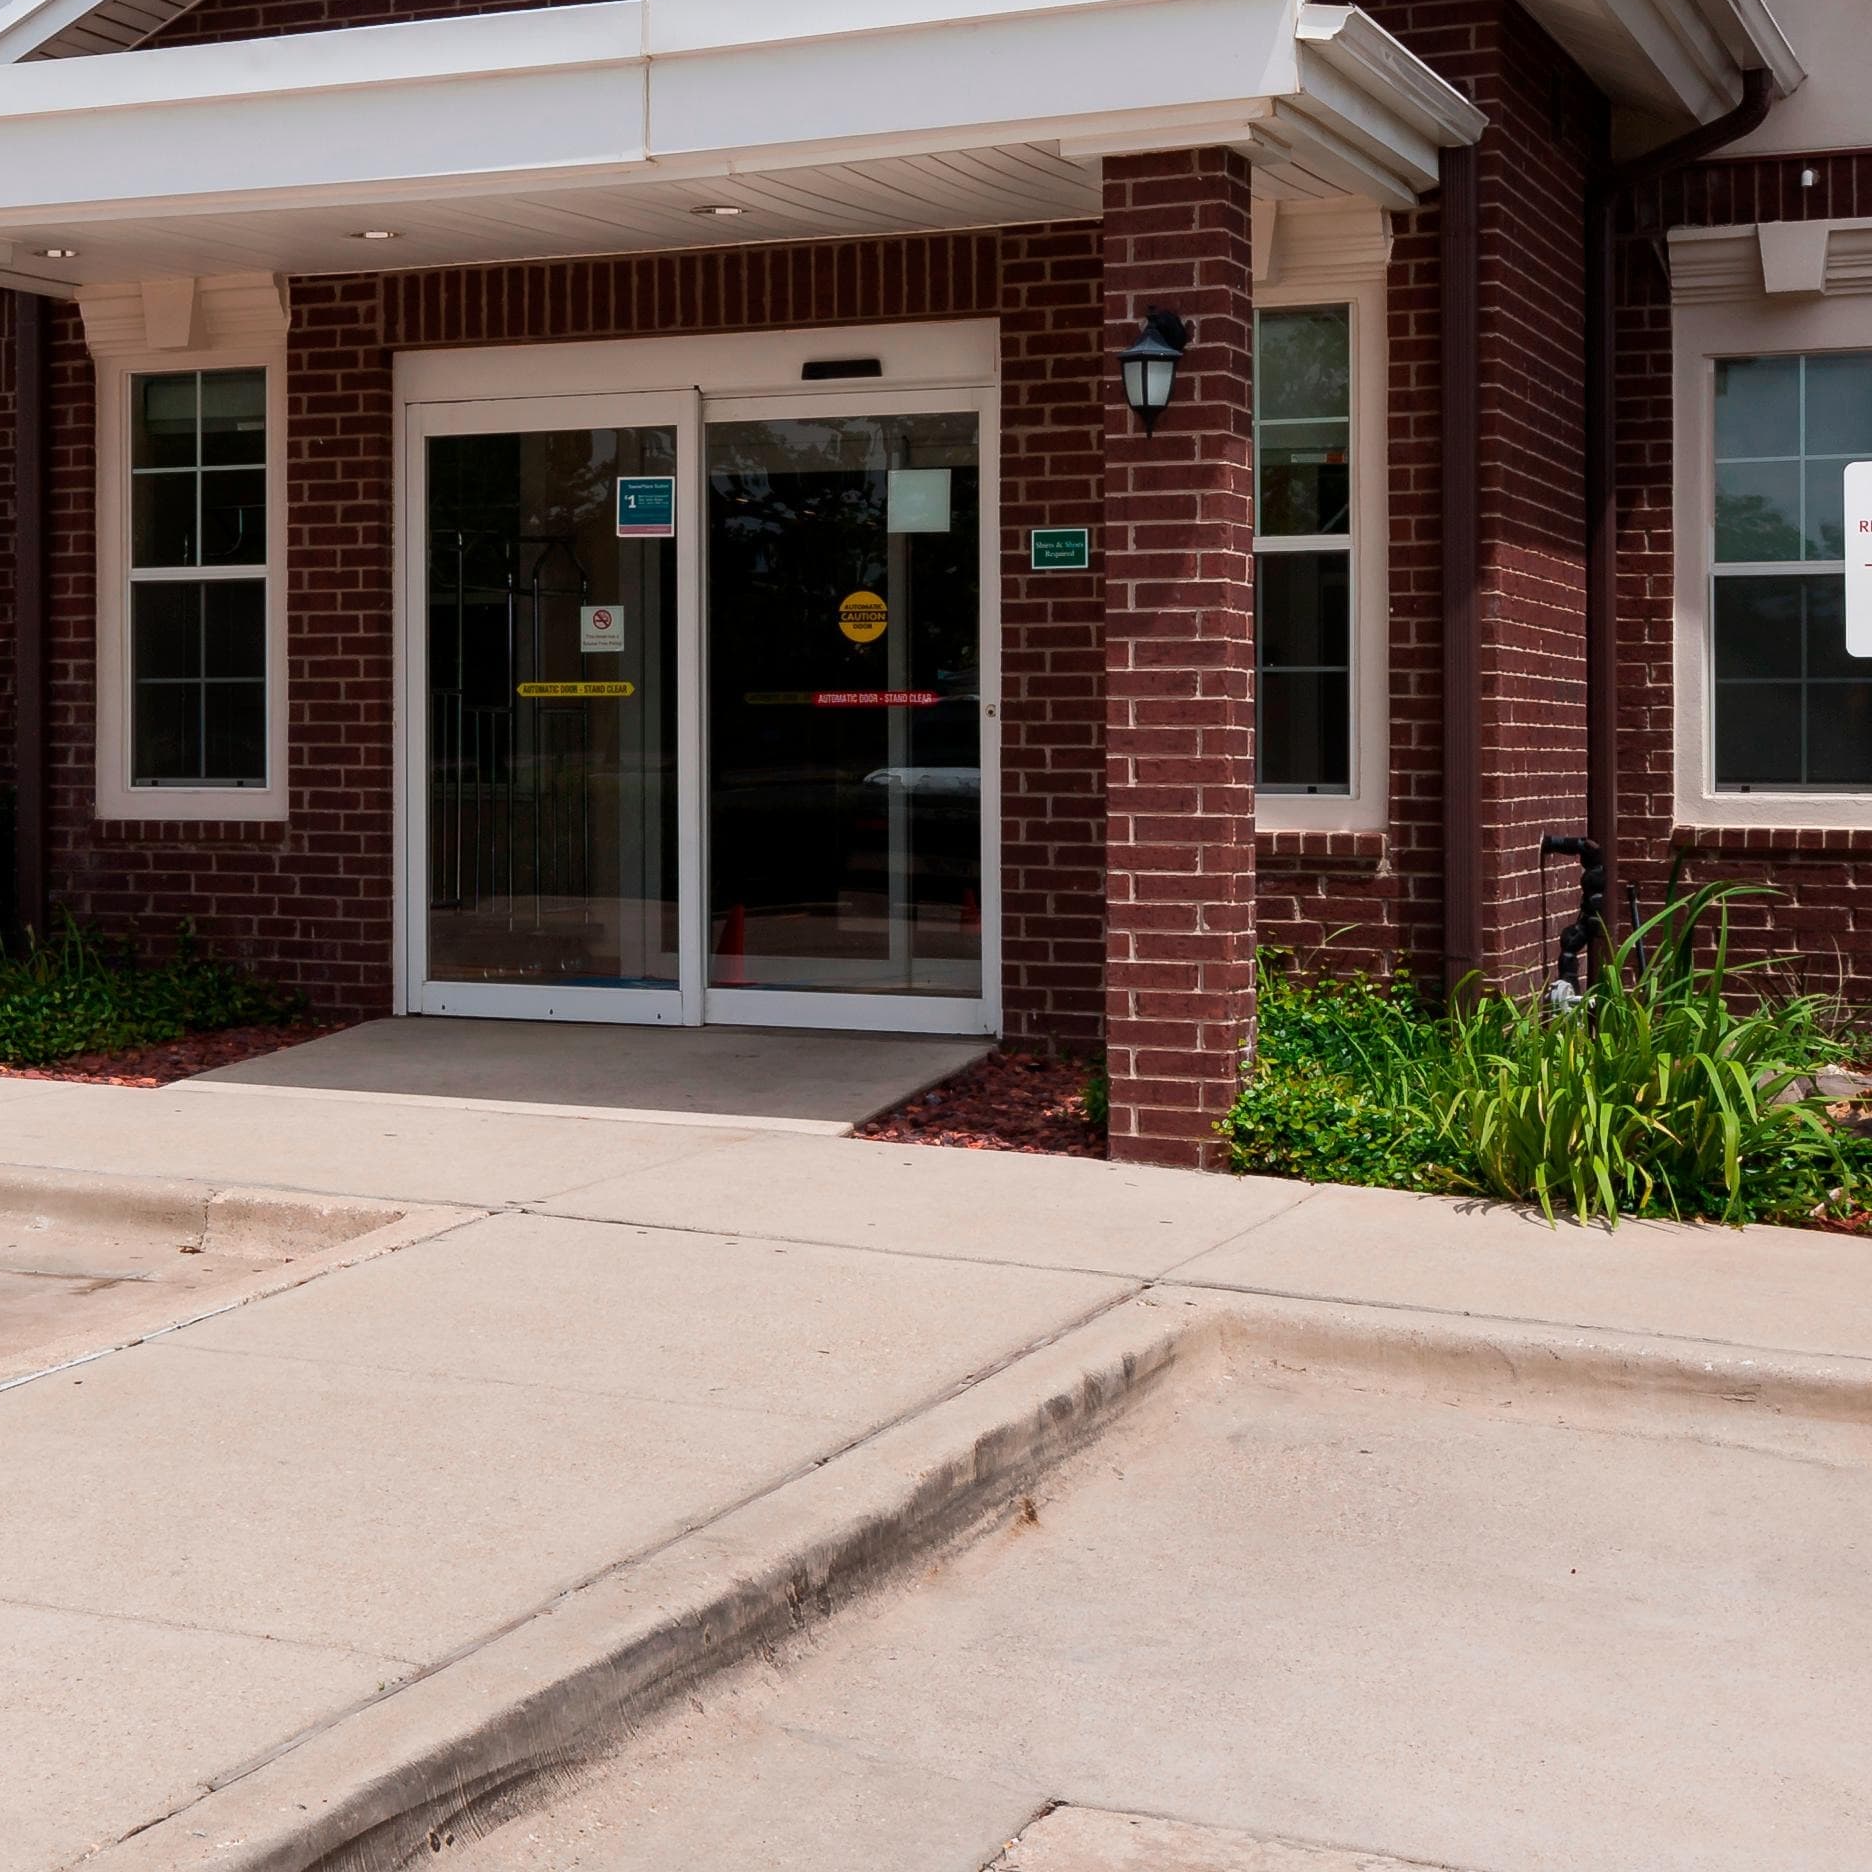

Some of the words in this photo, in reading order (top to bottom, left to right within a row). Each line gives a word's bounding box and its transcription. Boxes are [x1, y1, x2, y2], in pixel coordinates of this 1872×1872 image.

[841, 612, 886, 622] CAUTION
[523, 684, 559, 694] AUTOMATIC
[560, 684, 578, 694] DOOR
[584, 684, 605, 694] STAND
[607, 684, 627, 694] CLEAR
[818, 693, 857, 703] AUTOMATIC
[859, 693, 878, 703] DOOR
[885, 693, 908, 703] STAND
[909, 693, 932, 704] CLEAR
